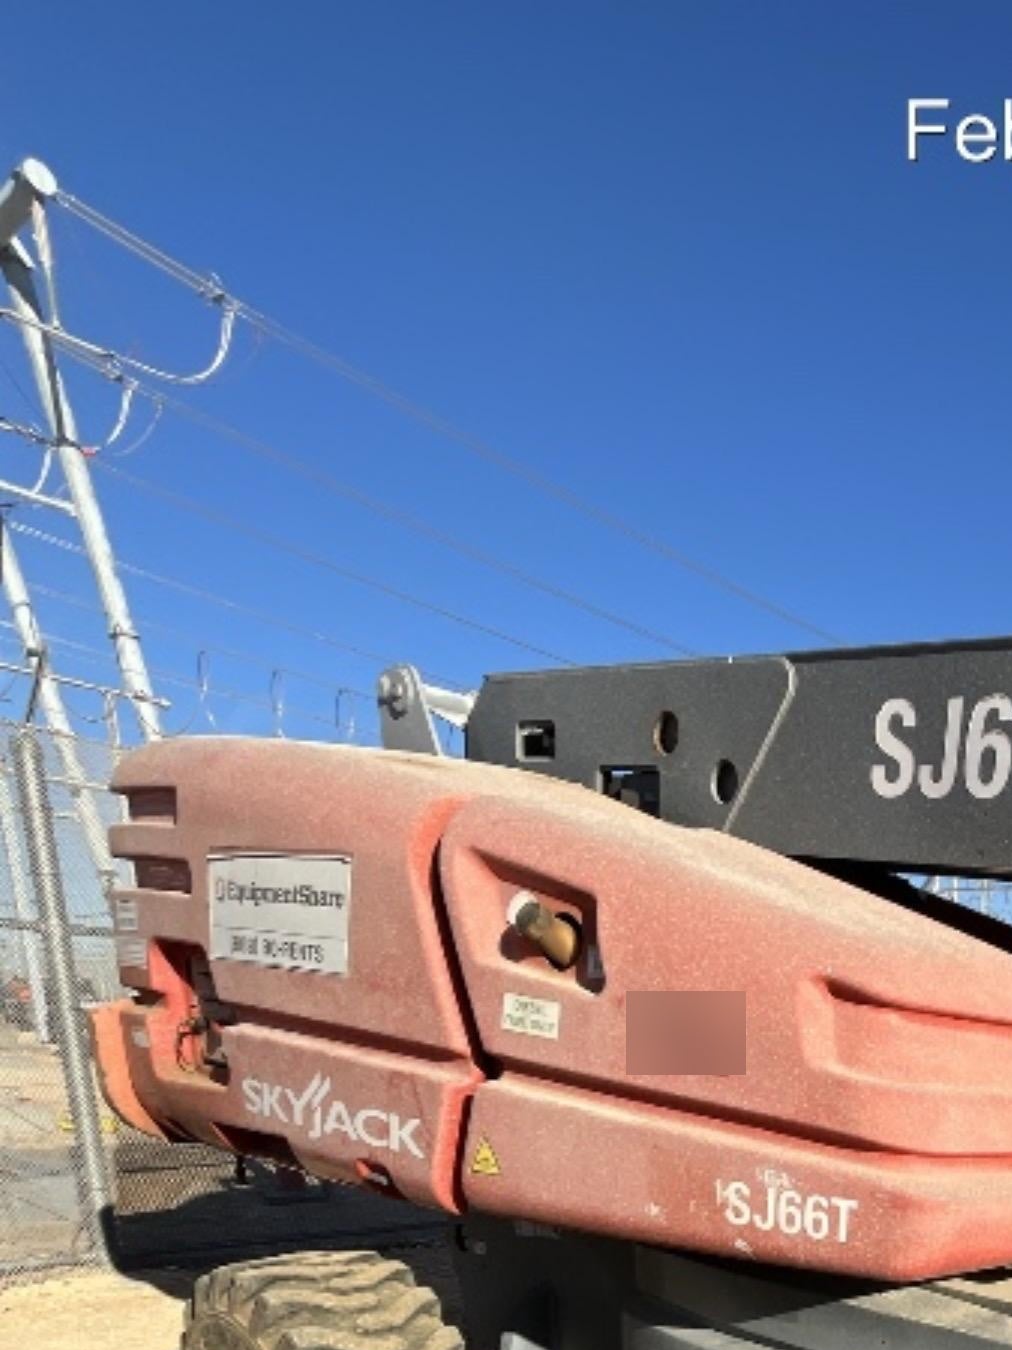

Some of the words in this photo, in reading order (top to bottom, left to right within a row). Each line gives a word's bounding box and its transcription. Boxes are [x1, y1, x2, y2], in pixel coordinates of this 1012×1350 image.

[227, 880, 345, 910] EquipmentShare
[240, 1070, 426, 1160] SKYJACK
[722, 1180, 859, 1244] SJ66T
